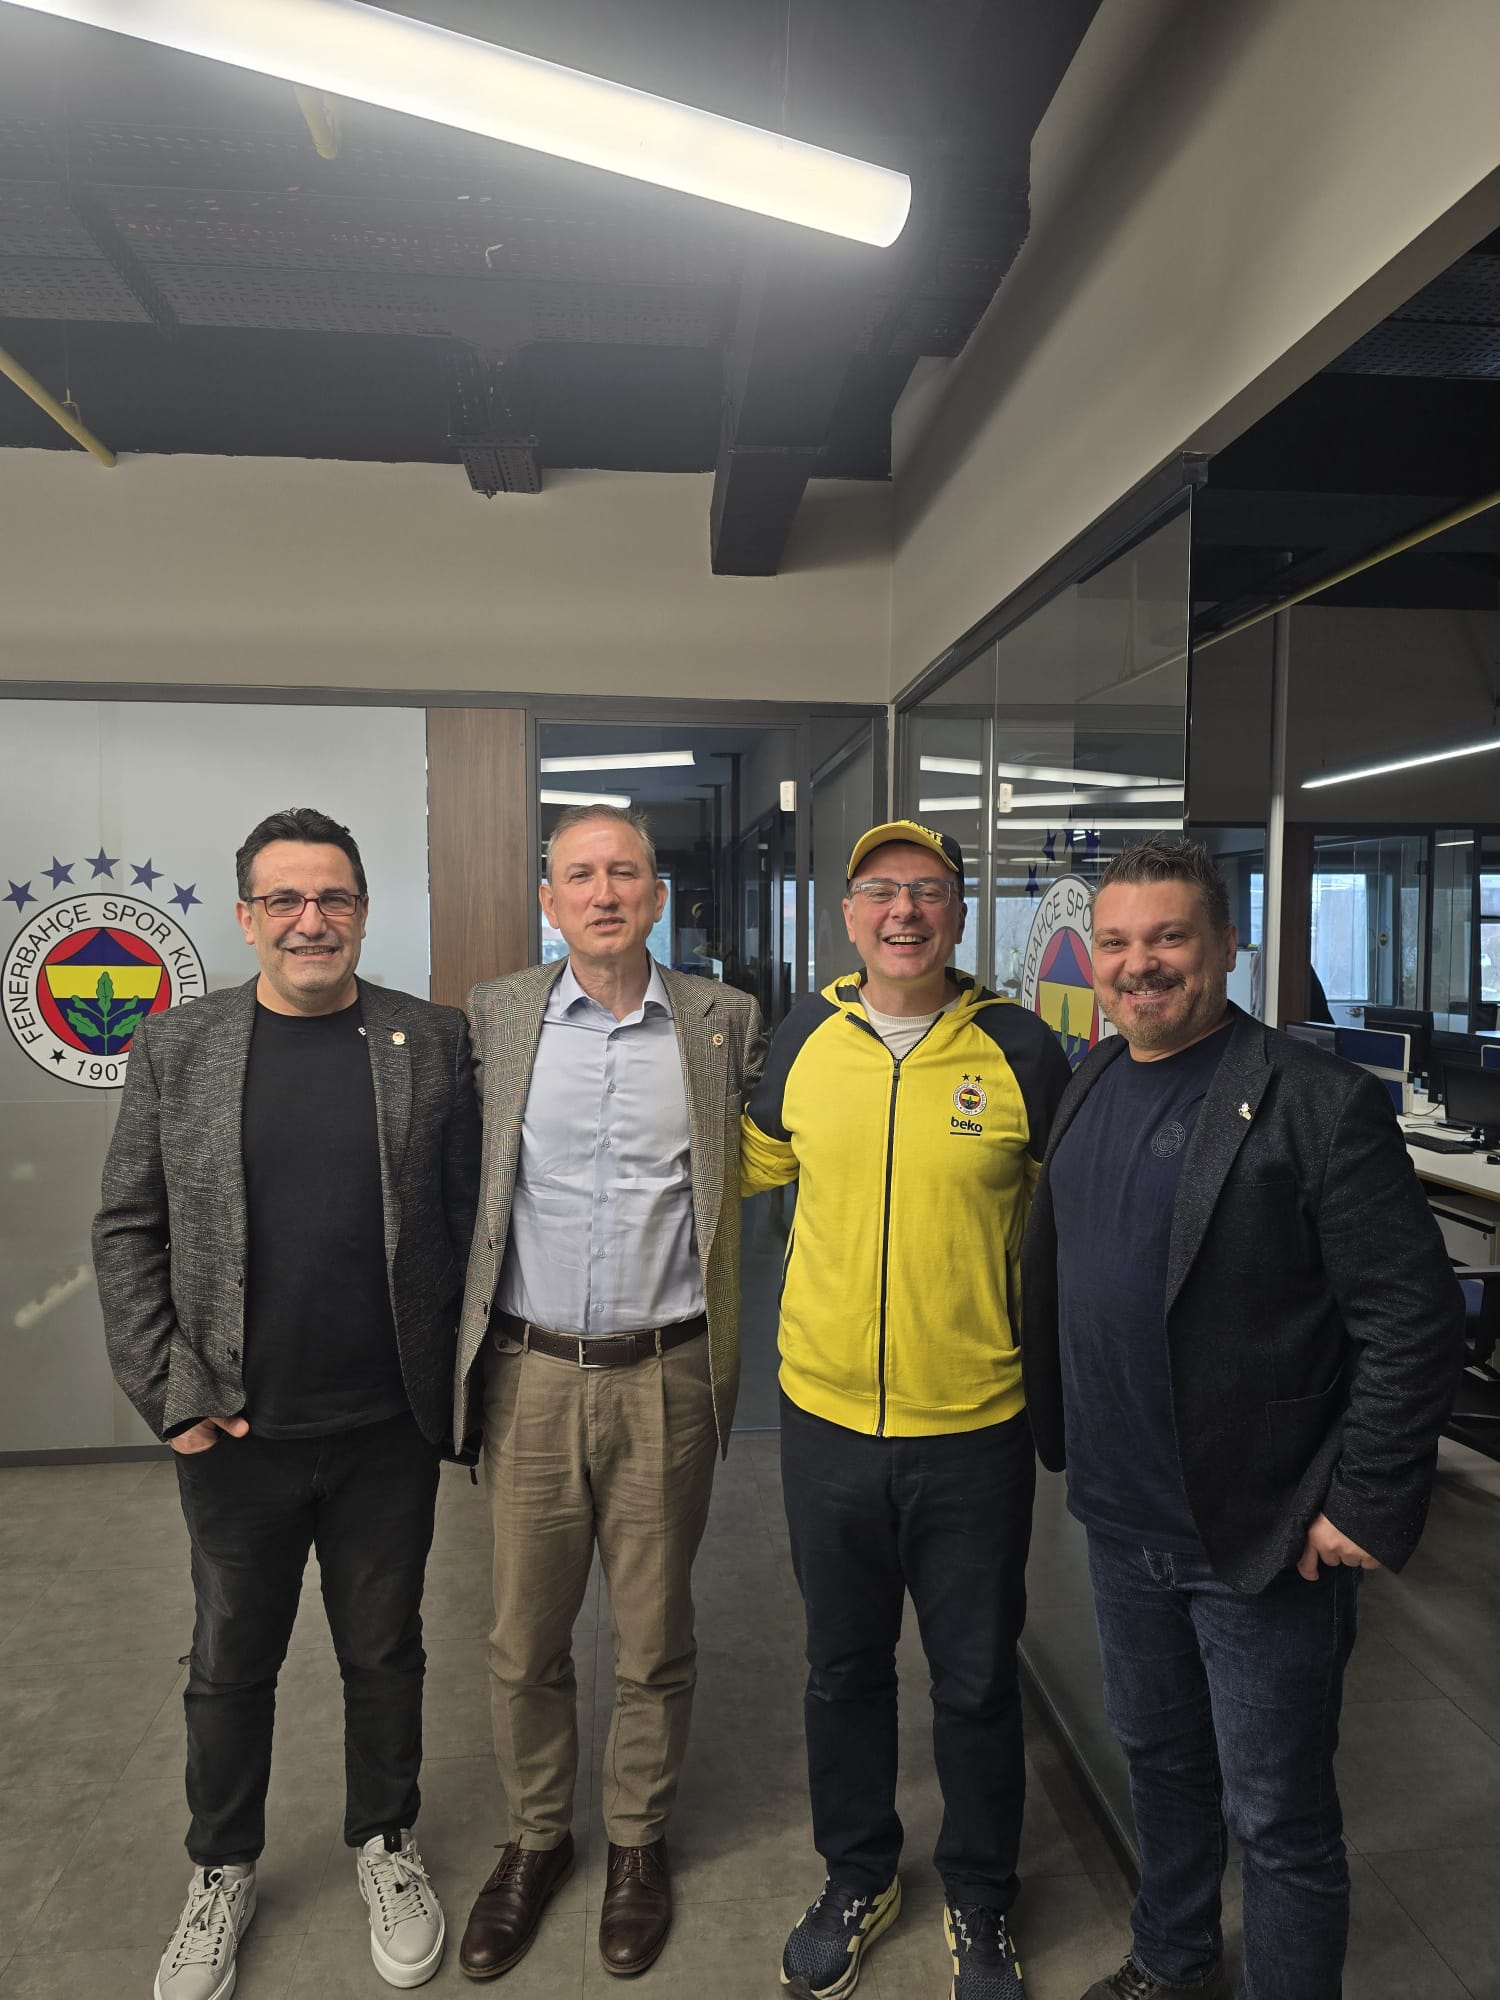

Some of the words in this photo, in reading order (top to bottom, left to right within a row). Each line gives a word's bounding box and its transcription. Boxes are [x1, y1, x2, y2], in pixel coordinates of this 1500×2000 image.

[1066, 887, 1093, 939] SPO
[9, 902, 91, 1045] FENERBAHÇE
[102, 901, 172, 944] SPOR
[950, 1116, 983, 1133] beko
